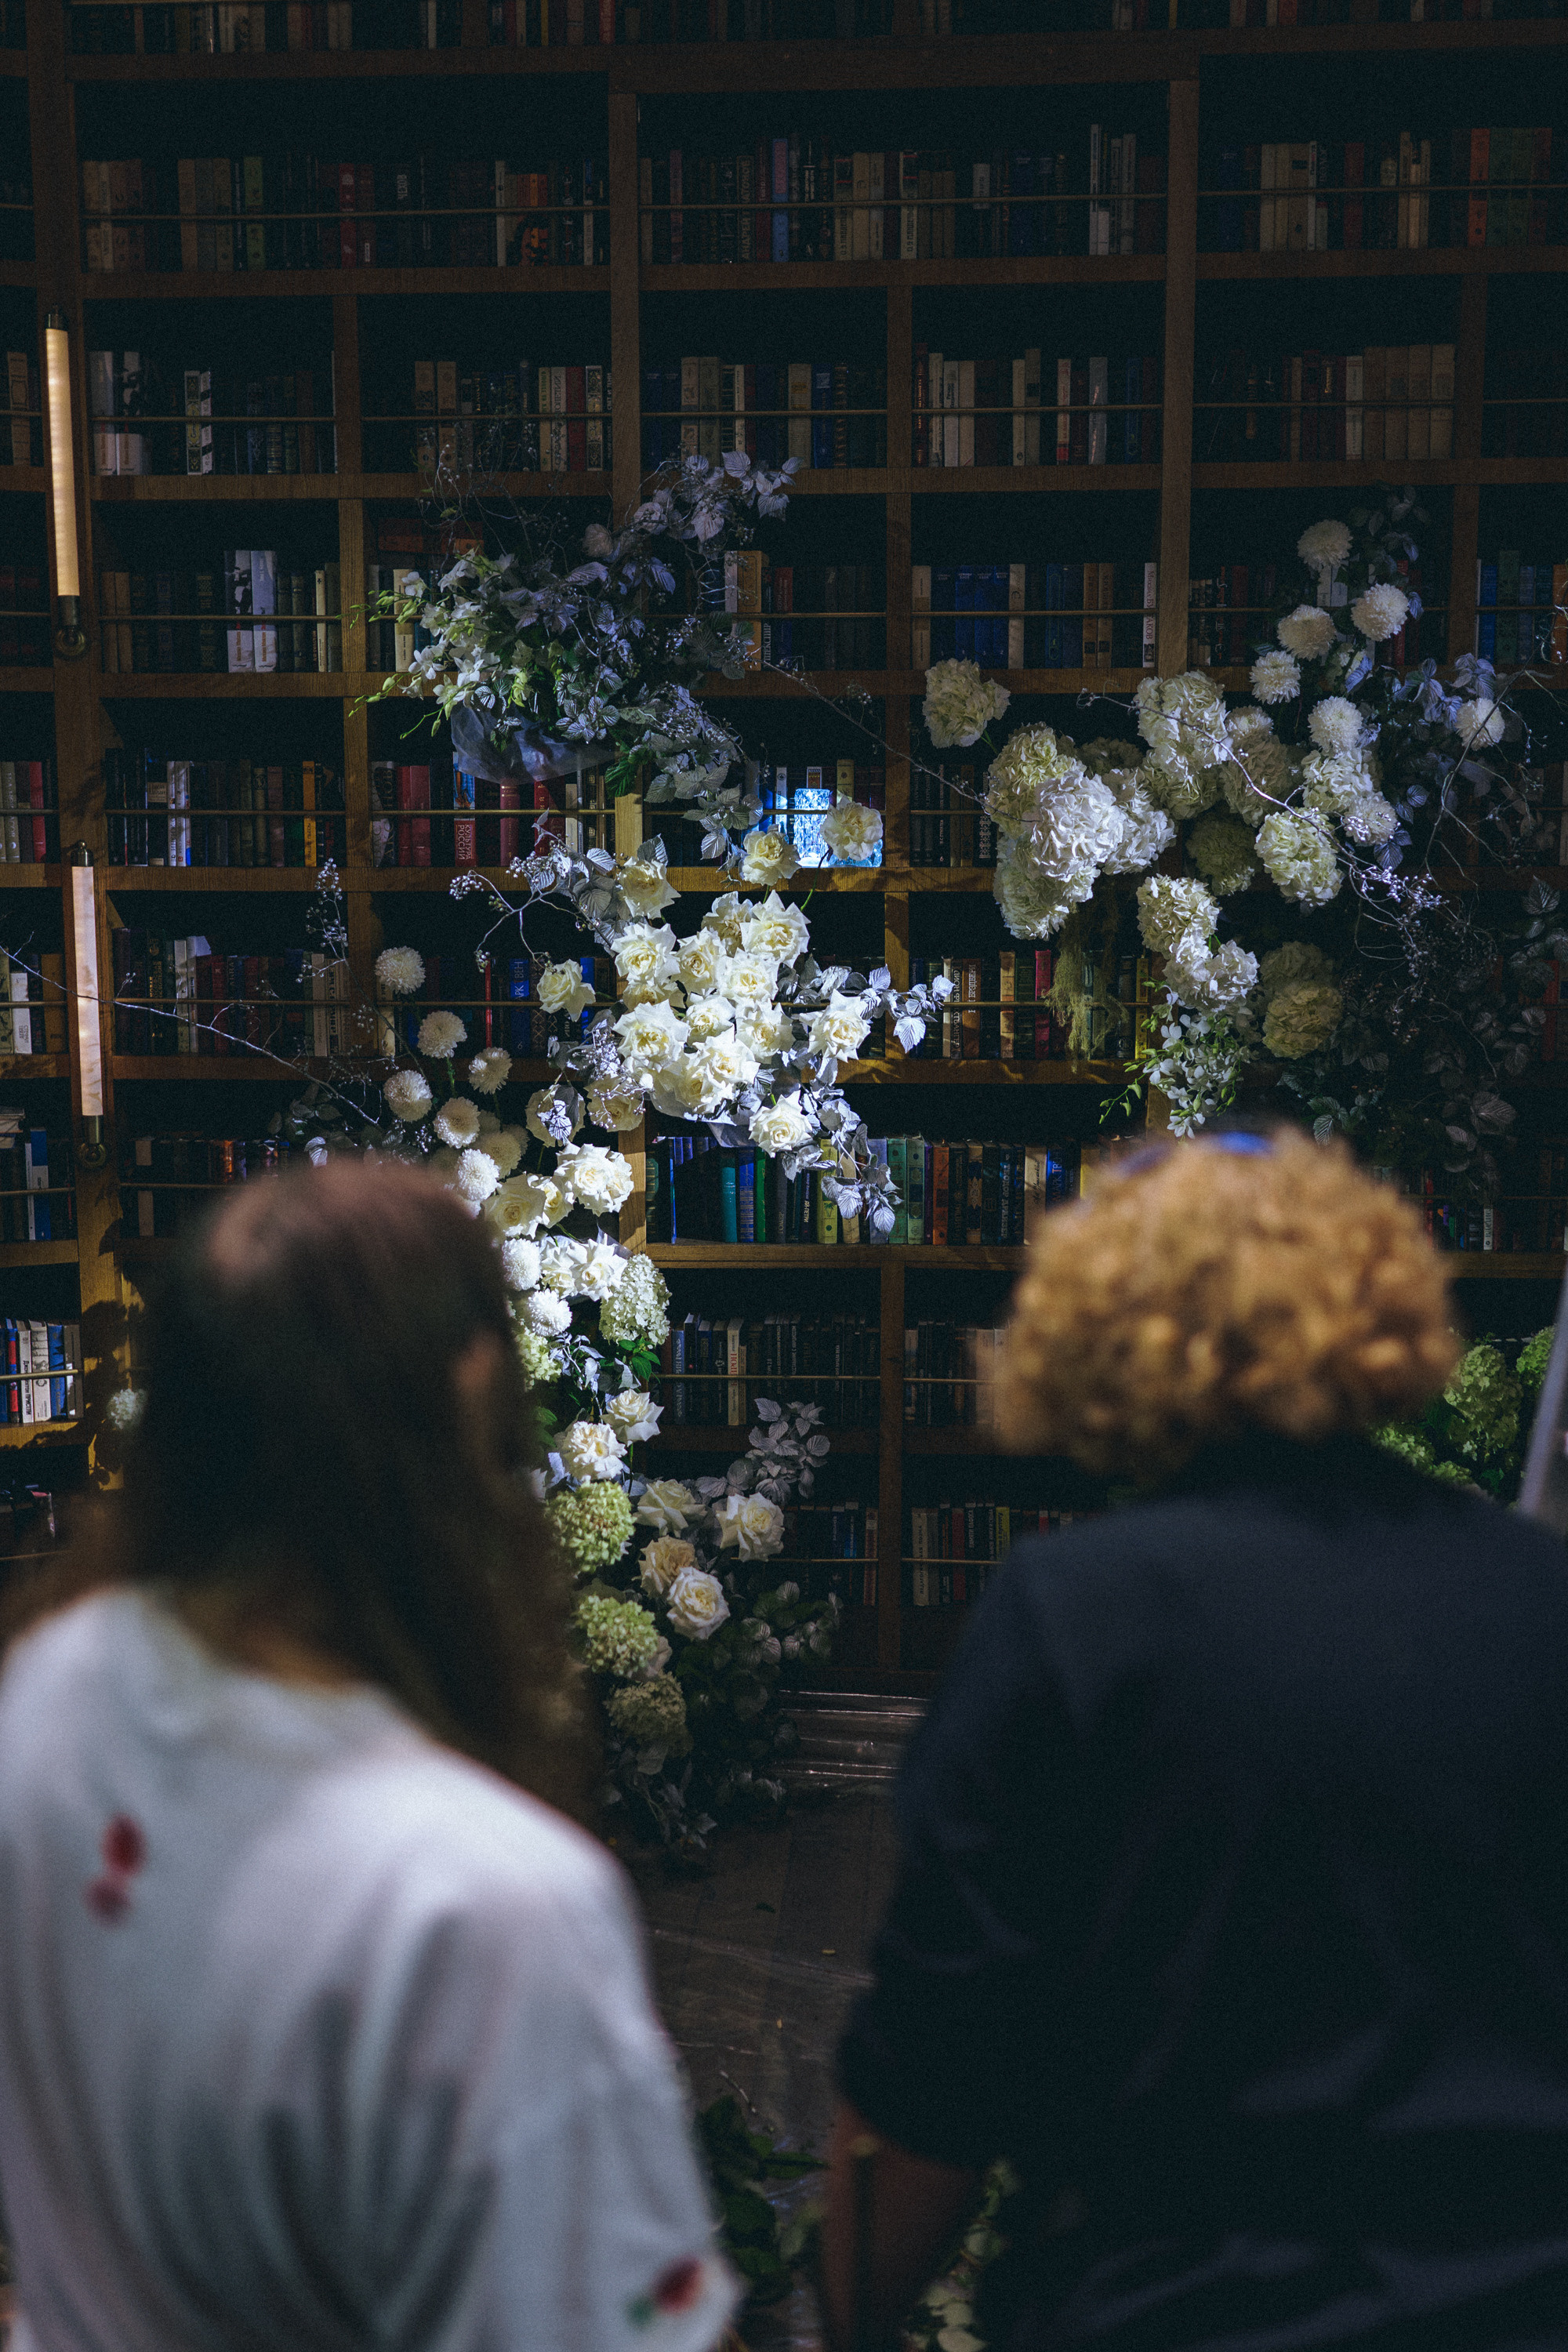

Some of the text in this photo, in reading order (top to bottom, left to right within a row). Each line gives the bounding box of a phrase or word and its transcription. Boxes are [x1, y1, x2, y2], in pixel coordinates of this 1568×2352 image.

[397, 174, 408, 200] ЧЕХОВ
[741, 160, 751, 261] АНДРЕЙ АТОНОВ
[1145, 598, 1155, 640] БУАКОВ
[381, 770, 394, 859] АКСНОВ
[514, 961, 524, 984] ТВЕН
[1000, 1163, 1011, 1239] ТЕОДОР ДРАЙЗЕР
[1051, 1150, 1063, 1201] МАРК ТВЕН
